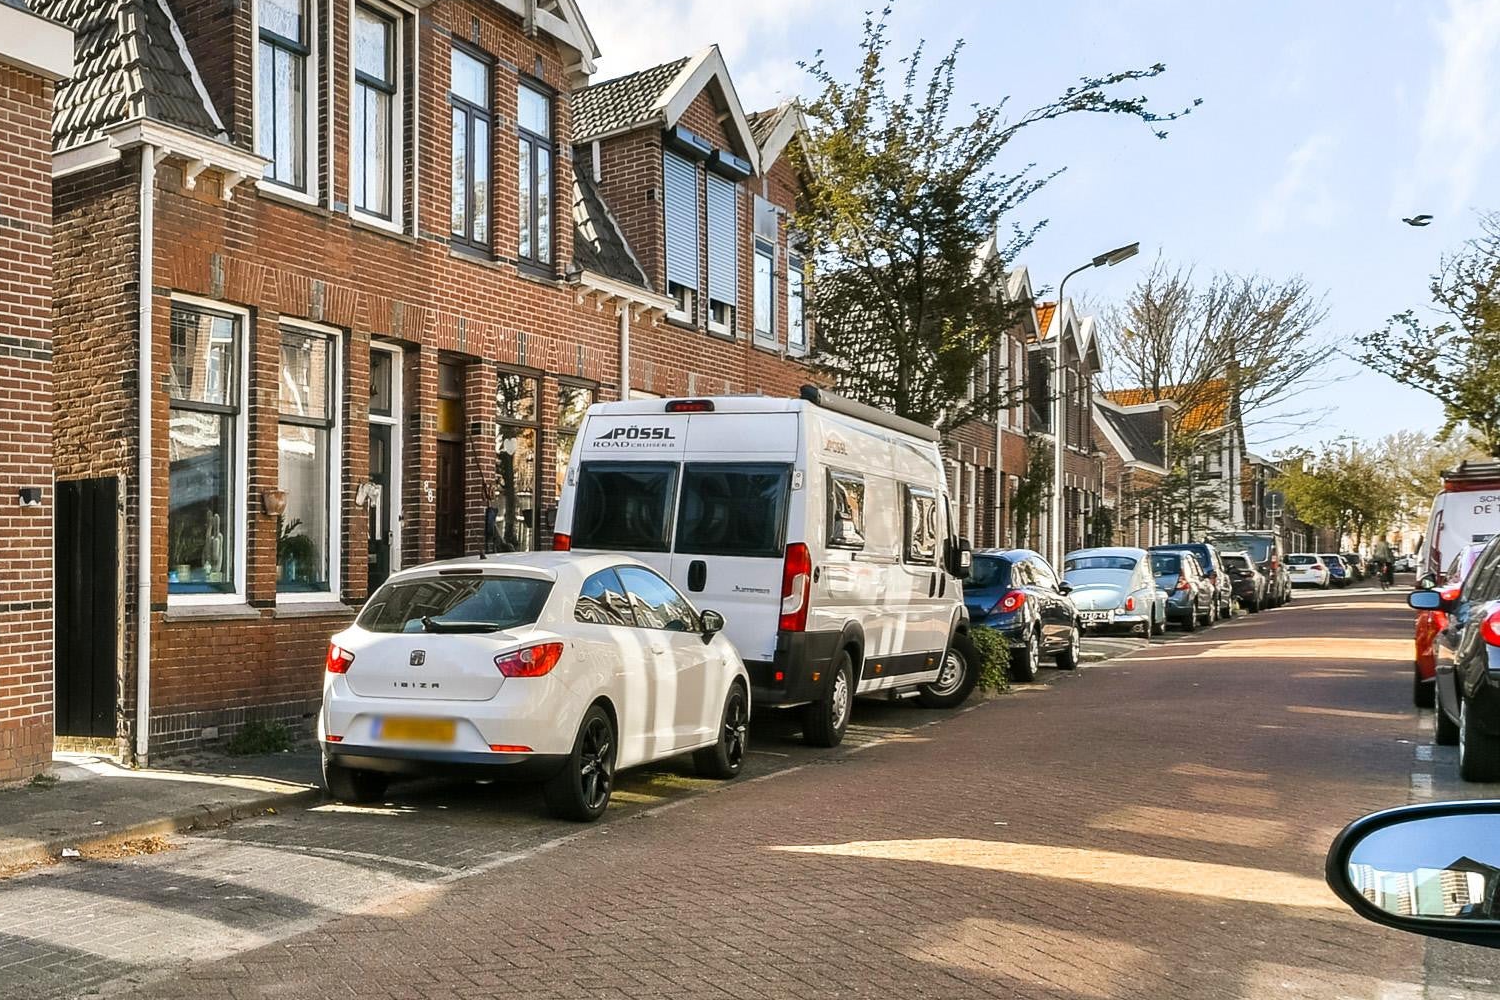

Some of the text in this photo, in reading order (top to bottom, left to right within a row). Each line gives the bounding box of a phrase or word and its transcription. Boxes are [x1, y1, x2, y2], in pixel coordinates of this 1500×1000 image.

[613, 425, 676, 440] PÖSSL
[1473, 504, 1492, 515] DE
[393, 681, 440, 689] IBIZA
